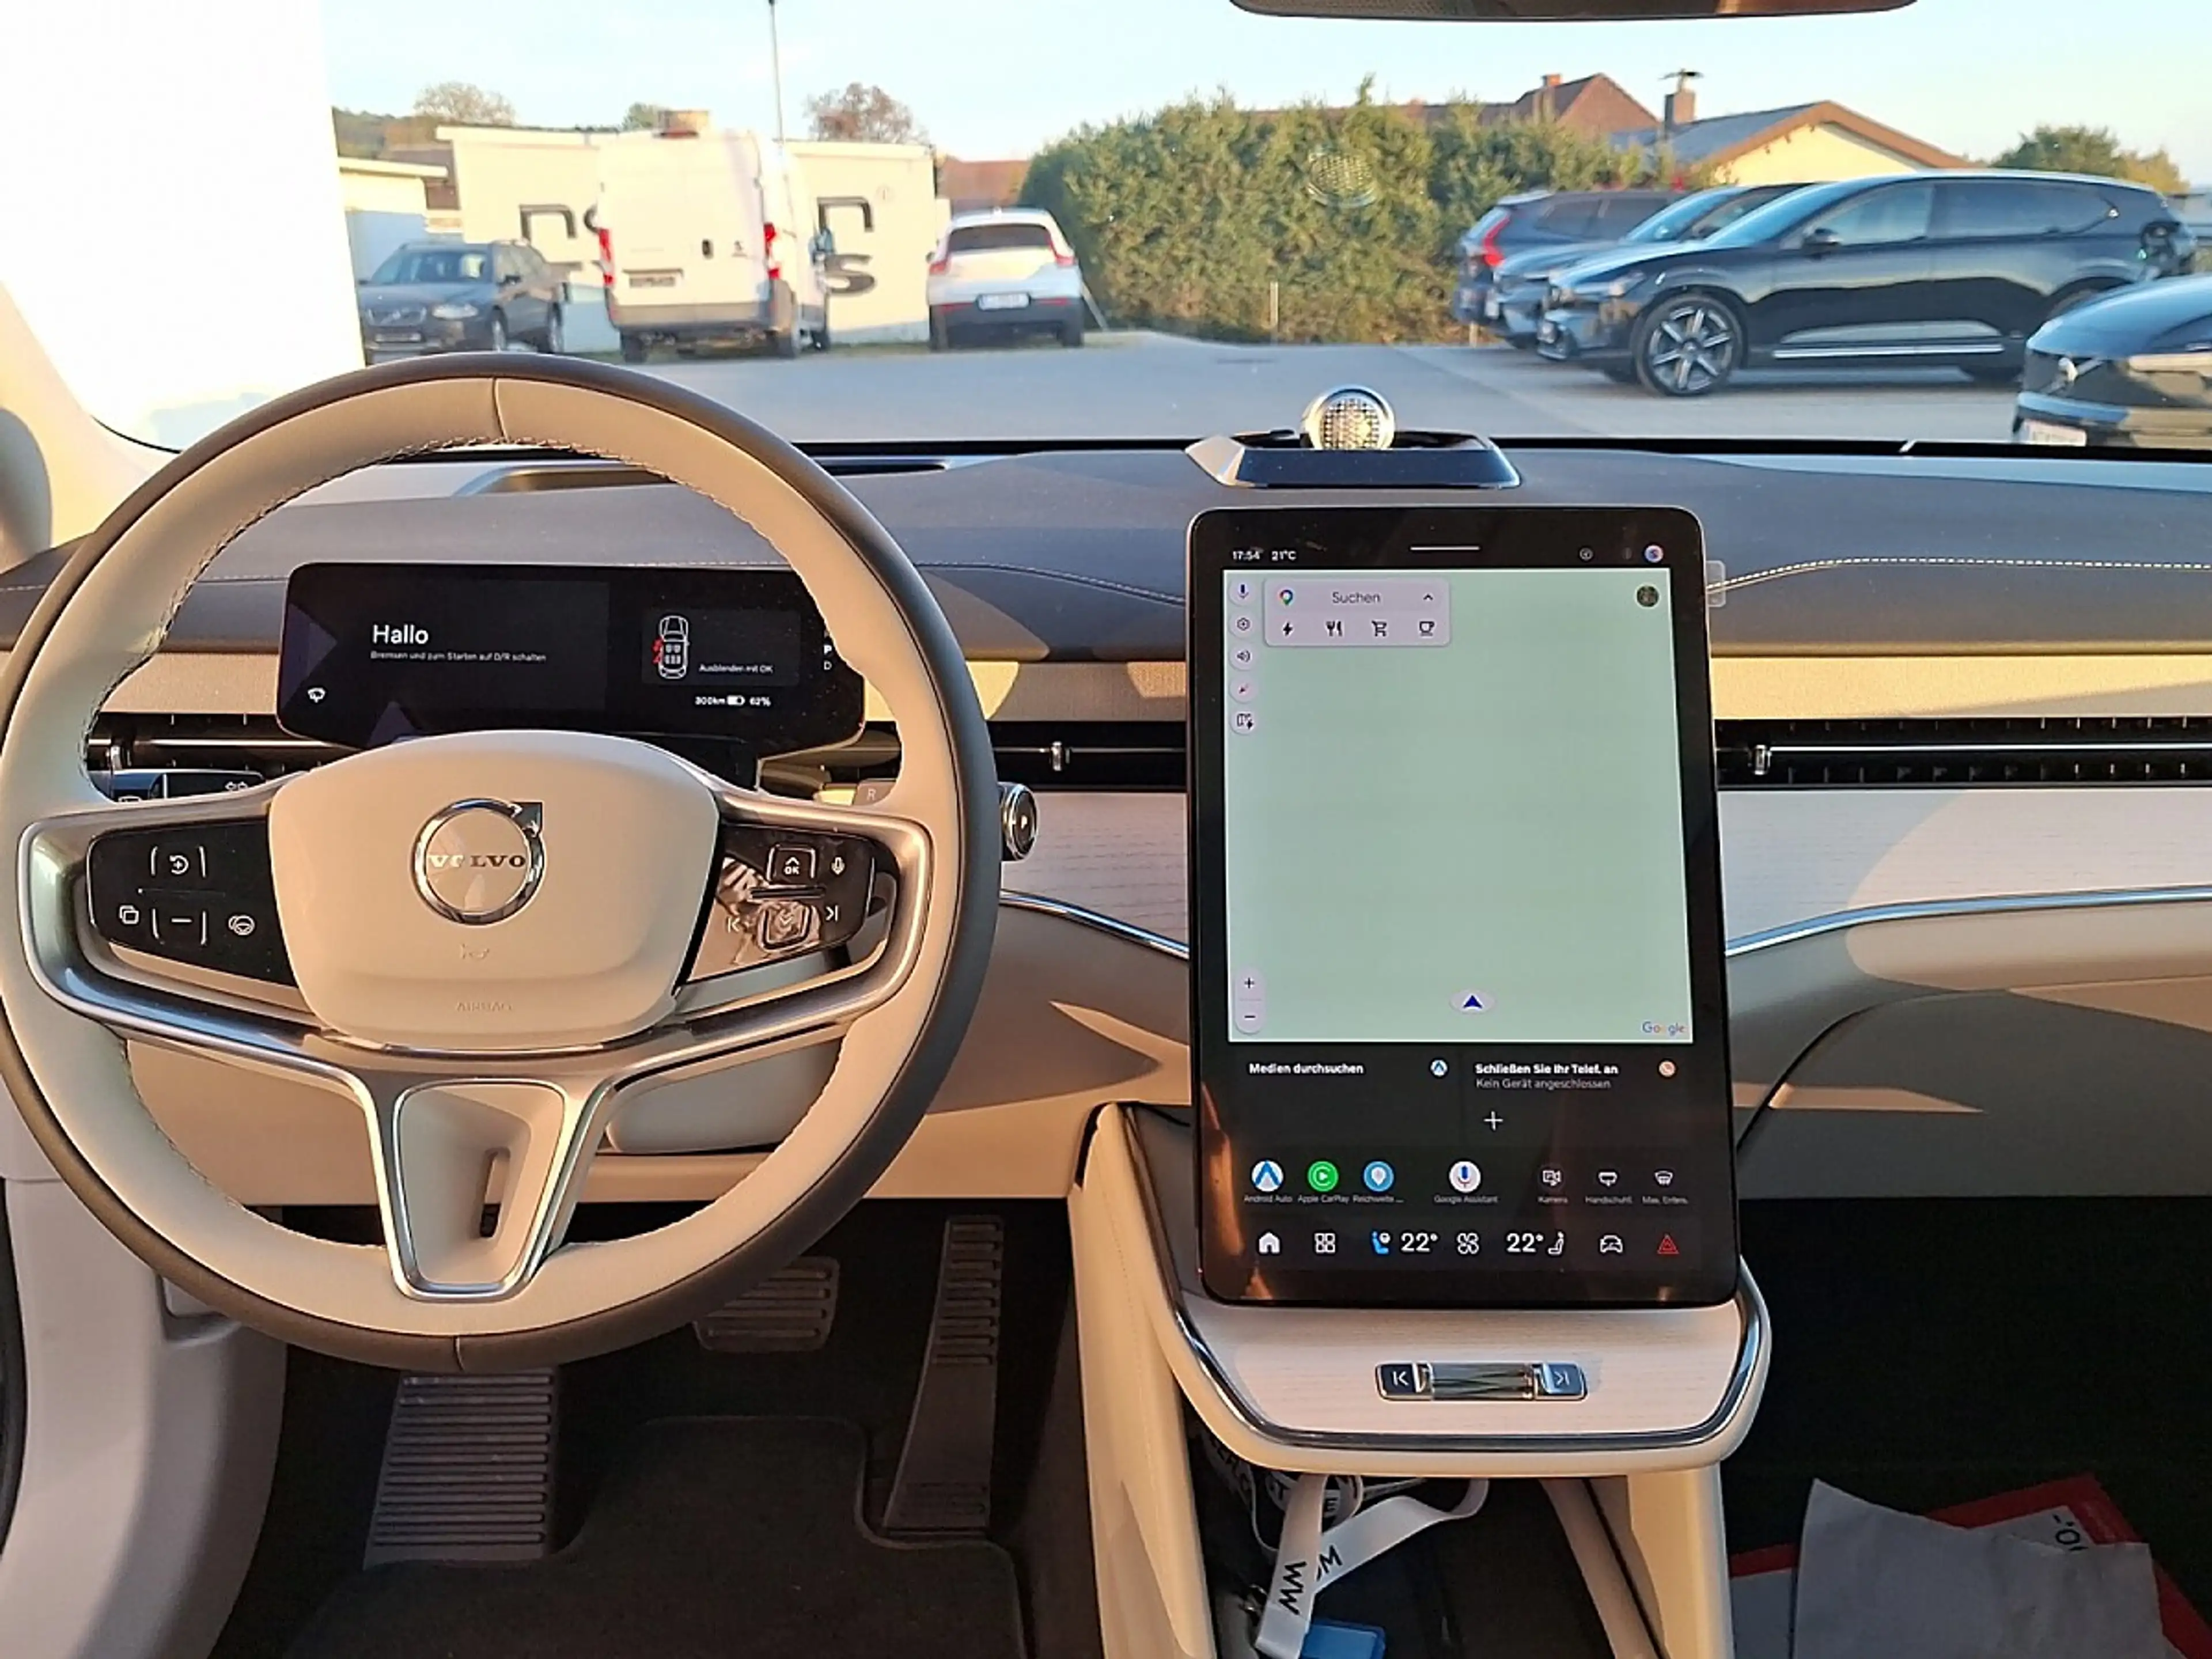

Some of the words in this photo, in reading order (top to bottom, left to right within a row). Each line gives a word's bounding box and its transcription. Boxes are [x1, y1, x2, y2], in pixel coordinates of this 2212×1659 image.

[1232, 550, 1260, 560] 17:54
[1271, 551, 1297, 560] 21°C
[1332, 591, 1380, 604] Suchen
[373, 624, 429, 644] Hallo
[410, 652, 425, 660] und
[868, 789, 877, 800] R
[429, 855, 526, 868] VOLVO
[784, 866, 800, 874] OK
[1249, 1063, 1291, 1074] Medien
[1293, 1063, 1364, 1074] durchsuchen
[1475, 1063, 1531, 1074] Schließen
[1533, 1063, 1551, 1074] Sie
[1554, 1064, 1570, 1074] Ihr
[1571, 1064, 1601, 1074] Telef.
[1604, 1066, 1618, 1074] an
[1476, 1079, 1499, 1089] Kein
[1502, 1079, 1532, 1089] Gerät
[1533, 1079, 1611, 1091] angeschlossen
[1244, 1195, 1273, 1203] Android
[1275, 1195, 1293, 1203] Auto
[1298, 1195, 1319, 1205] Apple
[1321, 1195, 1350, 1205] CarPlay
[1401, 1233, 1438, 1252] 22°
[1506, 1233, 1544, 1253] 22°
